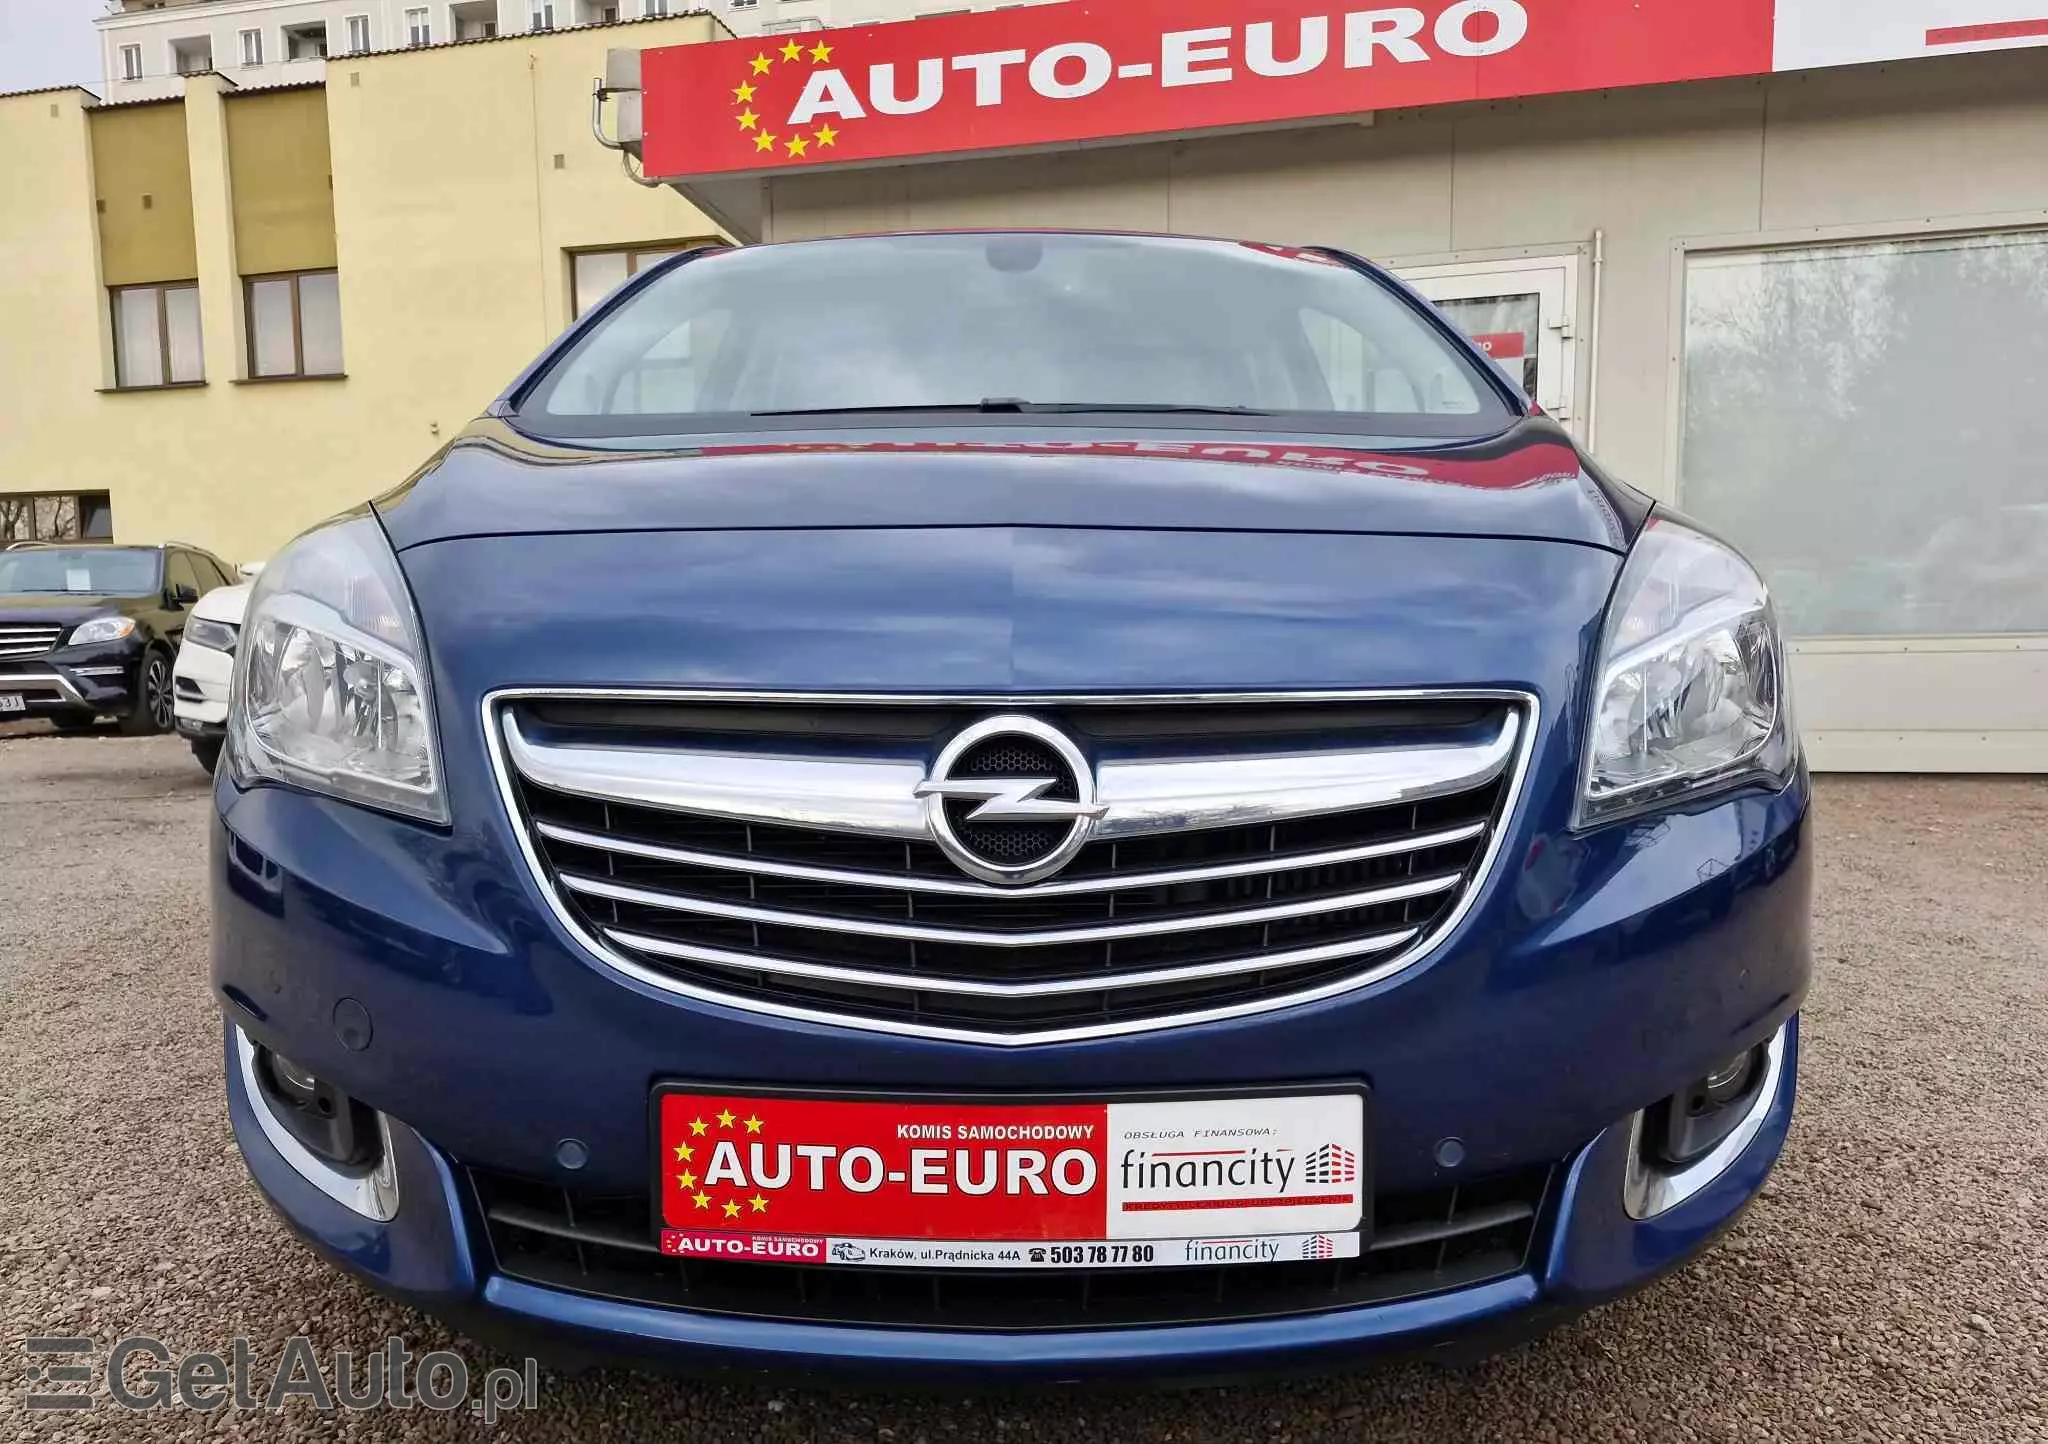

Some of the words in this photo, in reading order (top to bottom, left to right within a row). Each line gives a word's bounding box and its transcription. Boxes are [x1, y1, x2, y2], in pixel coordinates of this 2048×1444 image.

[786, 0, 1528, 126] AUTO-EURO
[897, 1124, 952, 1139] KOMIS
[957, 1124, 1095, 1140] SAMOCHODOWY
[1194, 1127, 1280, 1138] FINANSOWA:
[703, 1140, 1098, 1197] AUTO-EURO
[1120, 1148, 1295, 1193] financity
[678, 1237, 820, 1257] AUTO-EURO
[869, 1247, 917, 1260] Kraków,
[920, 1249, 994, 1262] ul.Prądnicka
[997, 1250, 1021, 1261] 44A
[1050, 1246, 1084, 1264] 503
[1087, 1246, 1107, 1264] 78
[1110, 1246, 1129, 1263] 77
[1132, 1245, 1154, 1263] 80
[1184, 1238, 1280, 1262] financity
